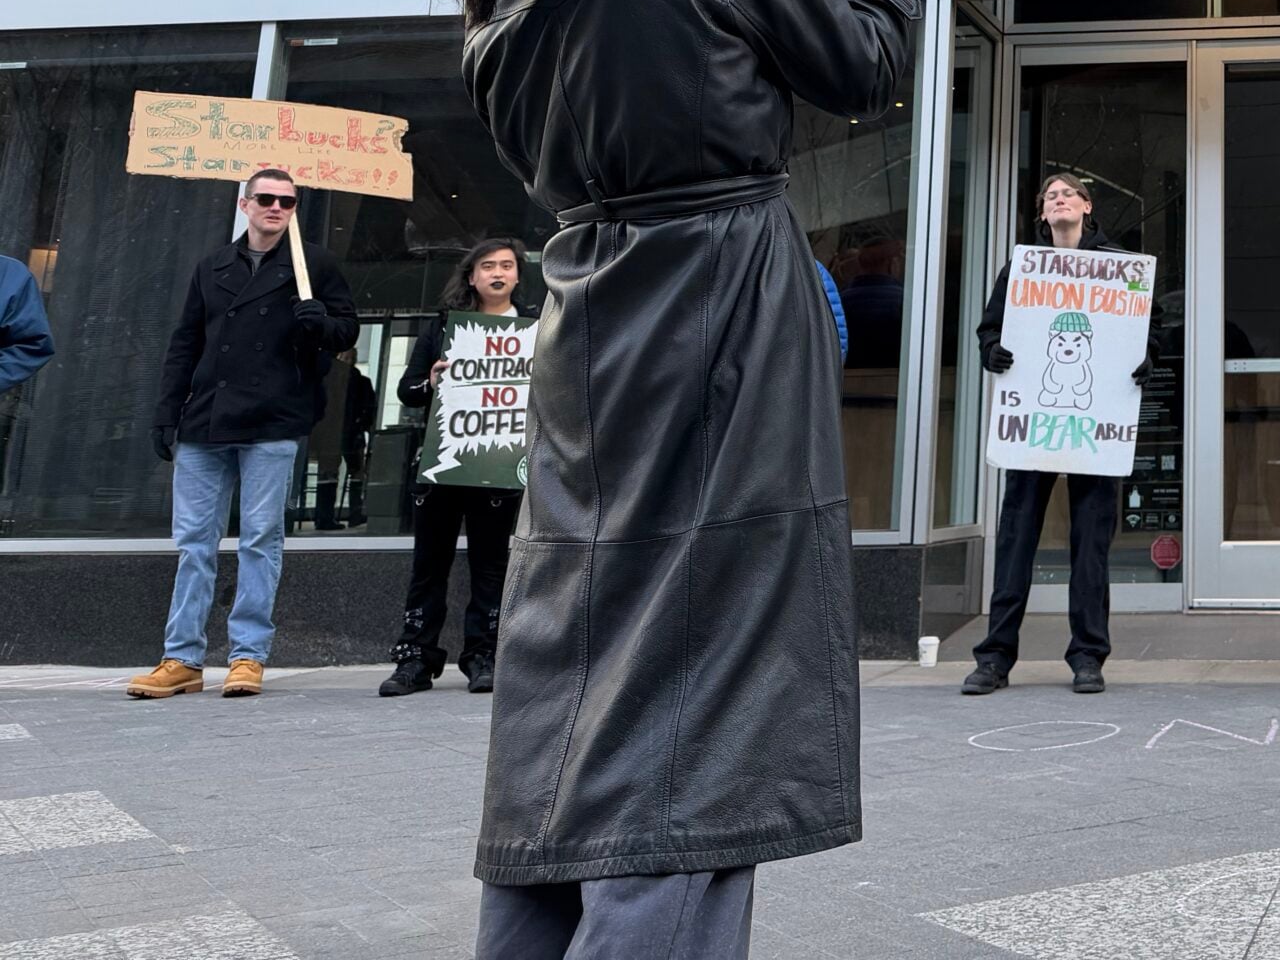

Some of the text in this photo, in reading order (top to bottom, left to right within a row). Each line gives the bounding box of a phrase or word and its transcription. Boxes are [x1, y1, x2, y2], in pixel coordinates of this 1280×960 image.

[1011, 279, 1085, 311] UNION
[485, 336, 521, 357] NO
[481, 386, 518, 408] NO
[1000, 390, 1021, 408] IS
[450, 407, 526, 438] COFFE
[997, 412, 1138, 454] UNBEARABLE
[966, 718, 1280, 752] ON
